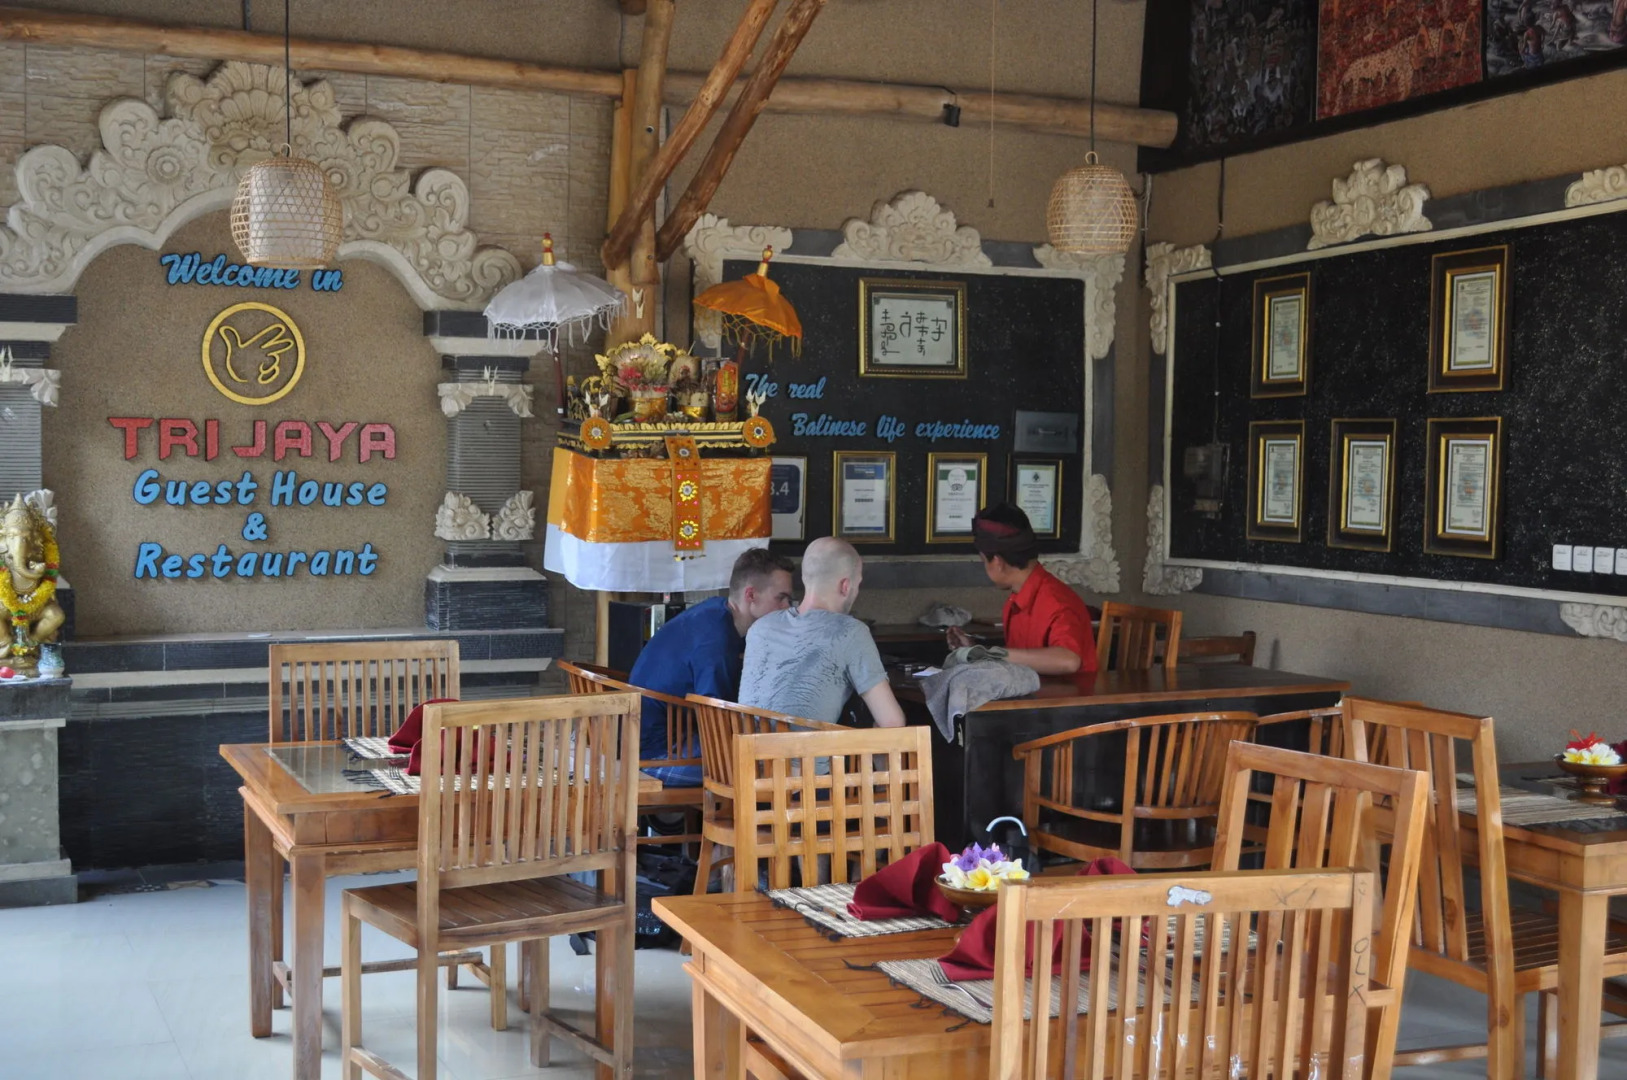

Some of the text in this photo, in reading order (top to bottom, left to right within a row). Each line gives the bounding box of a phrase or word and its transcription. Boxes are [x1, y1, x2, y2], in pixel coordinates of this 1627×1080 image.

[160, 252, 343, 292] Welcome in
[745, 373, 825, 399] The real
[107, 417, 397, 464] TRI JAYA
[791, 412, 1001, 444] Balinese life experience
[132, 468, 388, 507] Guest House
[241, 511, 269, 542] &
[135, 542, 379, 579] Restaurant
